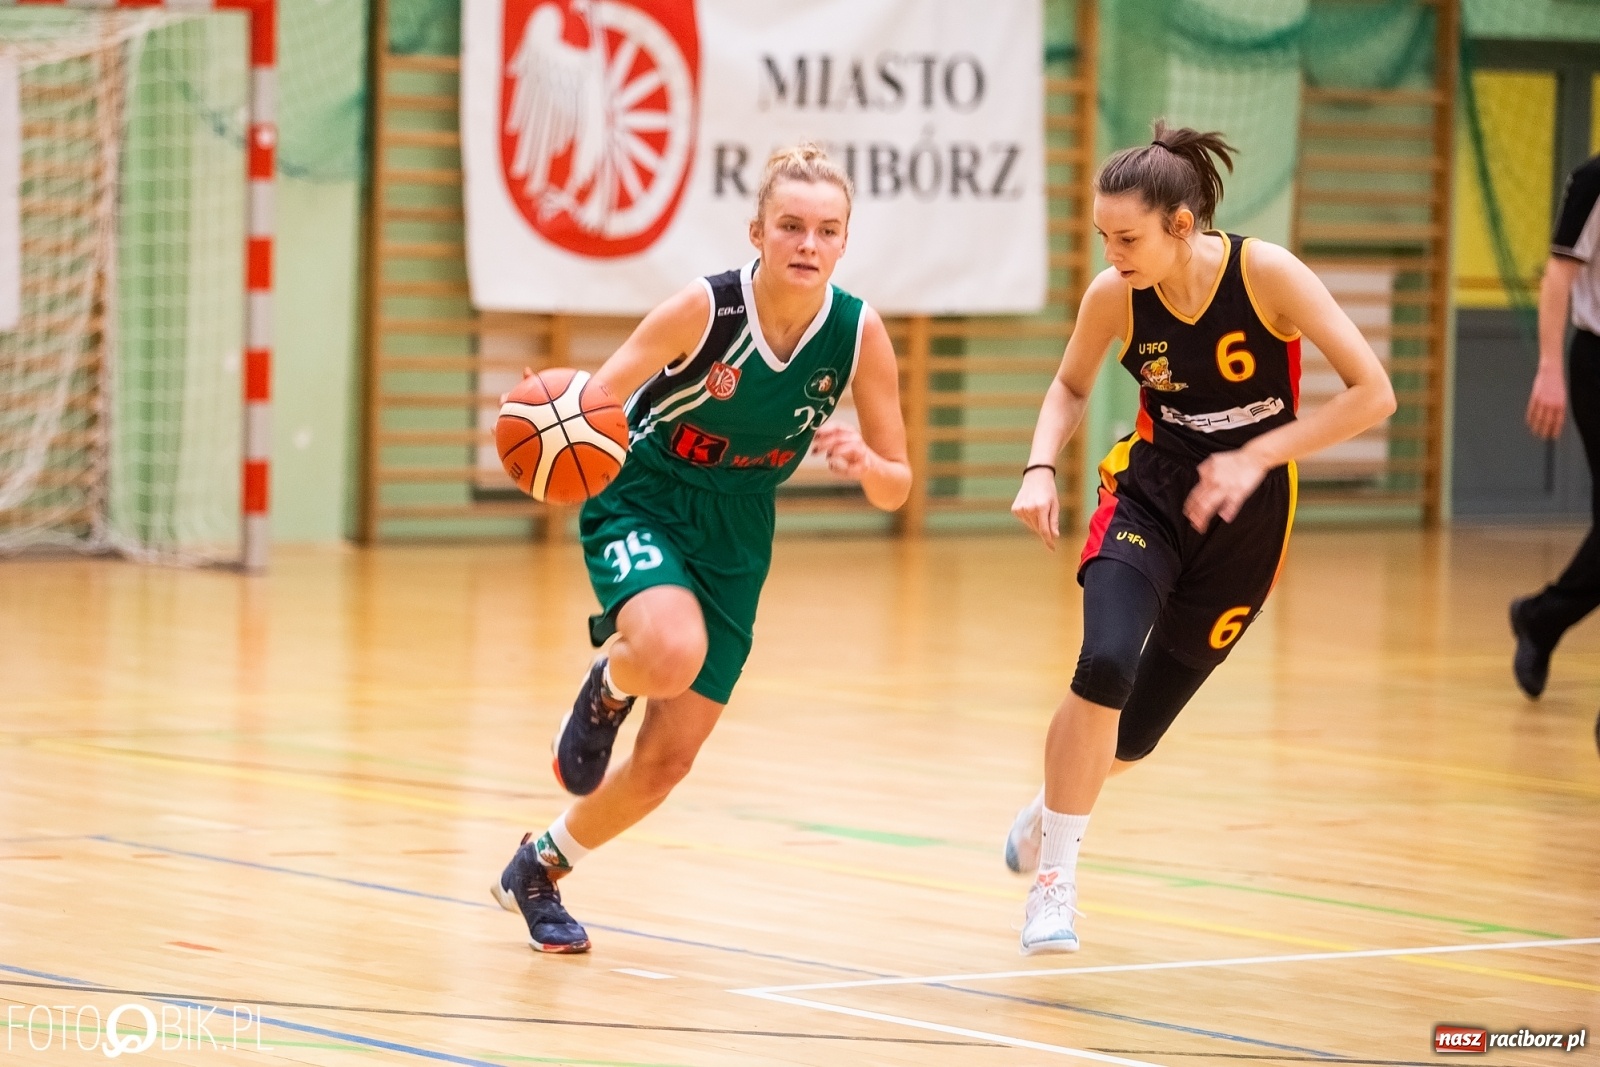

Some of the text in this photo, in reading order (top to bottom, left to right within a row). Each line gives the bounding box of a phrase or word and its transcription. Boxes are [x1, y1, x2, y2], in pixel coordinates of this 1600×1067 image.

[757, 52, 986, 113] MIASTO
[712, 124, 1024, 200] RIBÓRZ
[1216, 331, 1256, 382] 6
[603, 530, 664, 583] 35
[1209, 605, 1252, 649] 6
